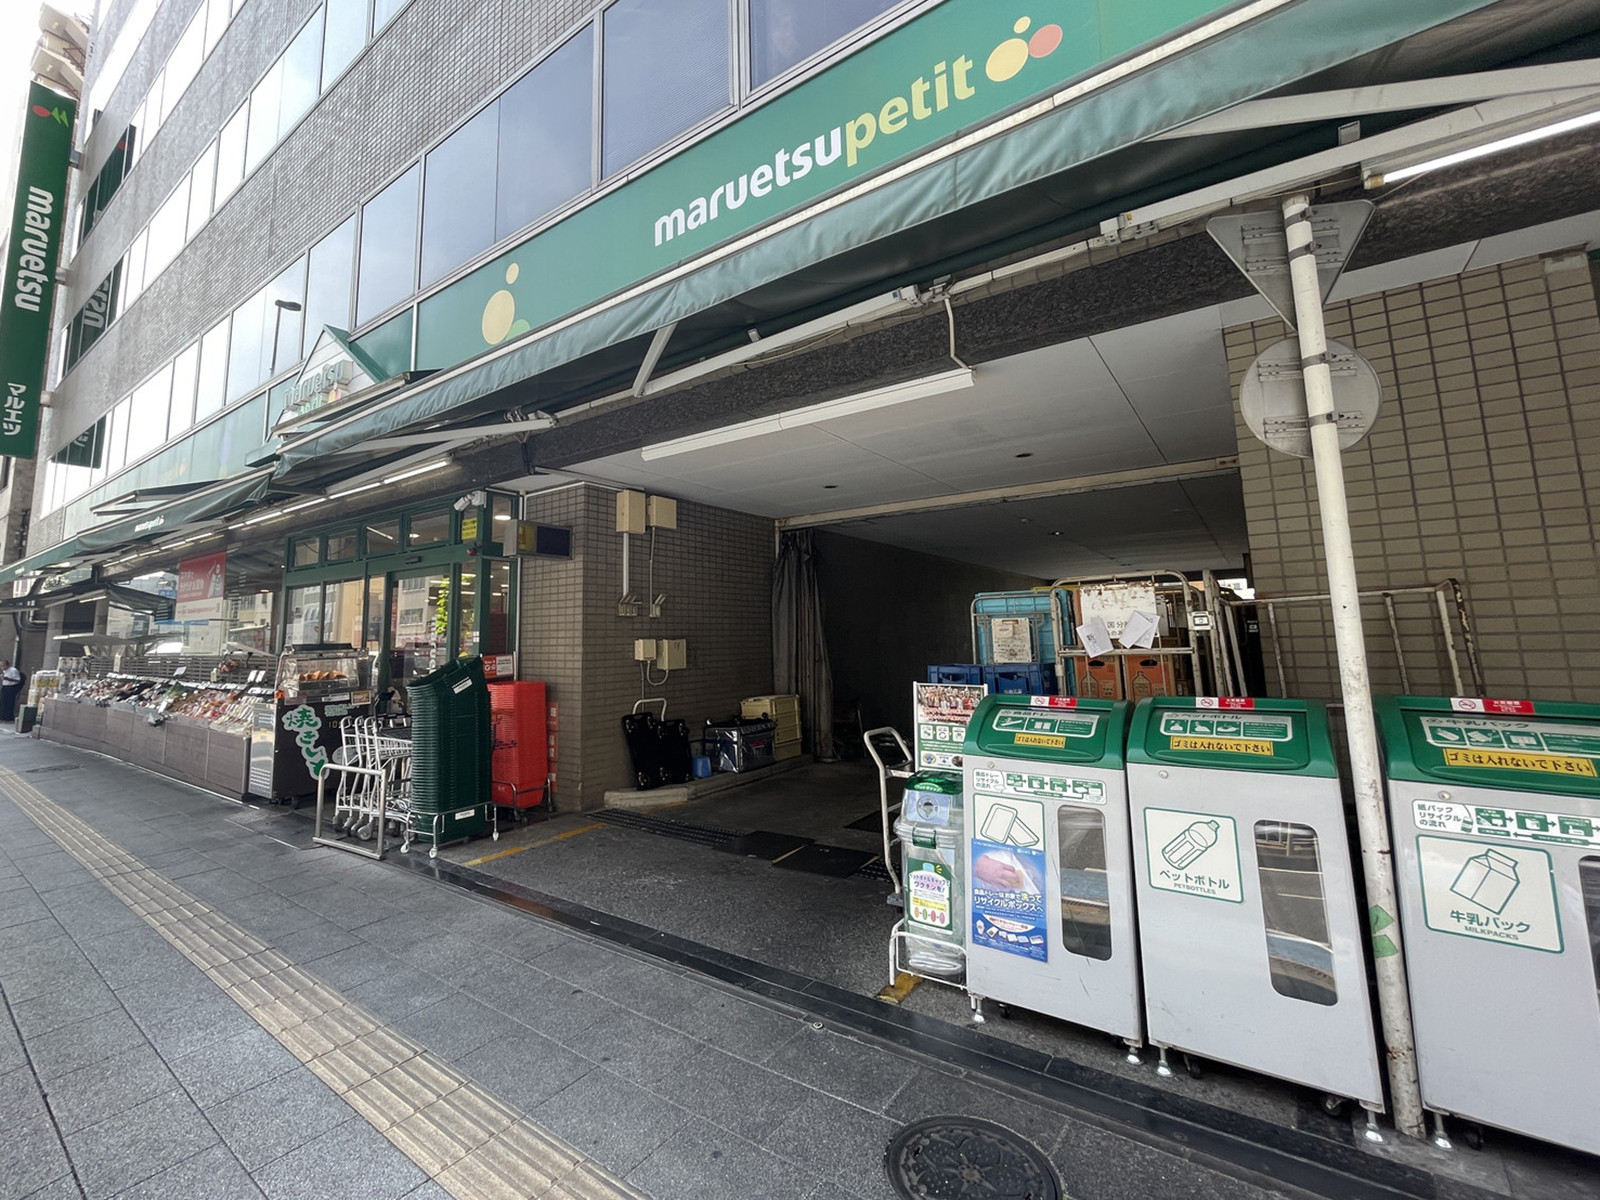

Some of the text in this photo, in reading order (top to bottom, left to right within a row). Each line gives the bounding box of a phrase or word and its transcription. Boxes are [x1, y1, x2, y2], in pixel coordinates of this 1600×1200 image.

[14, 186, 54, 312] maruetsu
[2, 382, 26, 436] マルエツ
[1180, 712, 1243, 721] ペットボトル
[1446, 717, 1530, 729] 牛乳パック
[1173, 739, 1272, 752] ゴミは入れないで下さい
[1449, 752, 1592, 773] ゴミは入れないで下さい
[1417, 803, 1453, 812] 紙パック
[1419, 812, 1462, 822] リサイクル
[1420, 819, 1447, 828] の流れ
[1160, 870, 1230, 889] ペットボトル
[1173, 883, 1216, 895] PETBOTTLES
[974, 896, 1044, 912] リサイクルボックスへ
[1450, 909, 1531, 933] 牛乳パック
[1464, 925, 1519, 940] MILKPACKS
